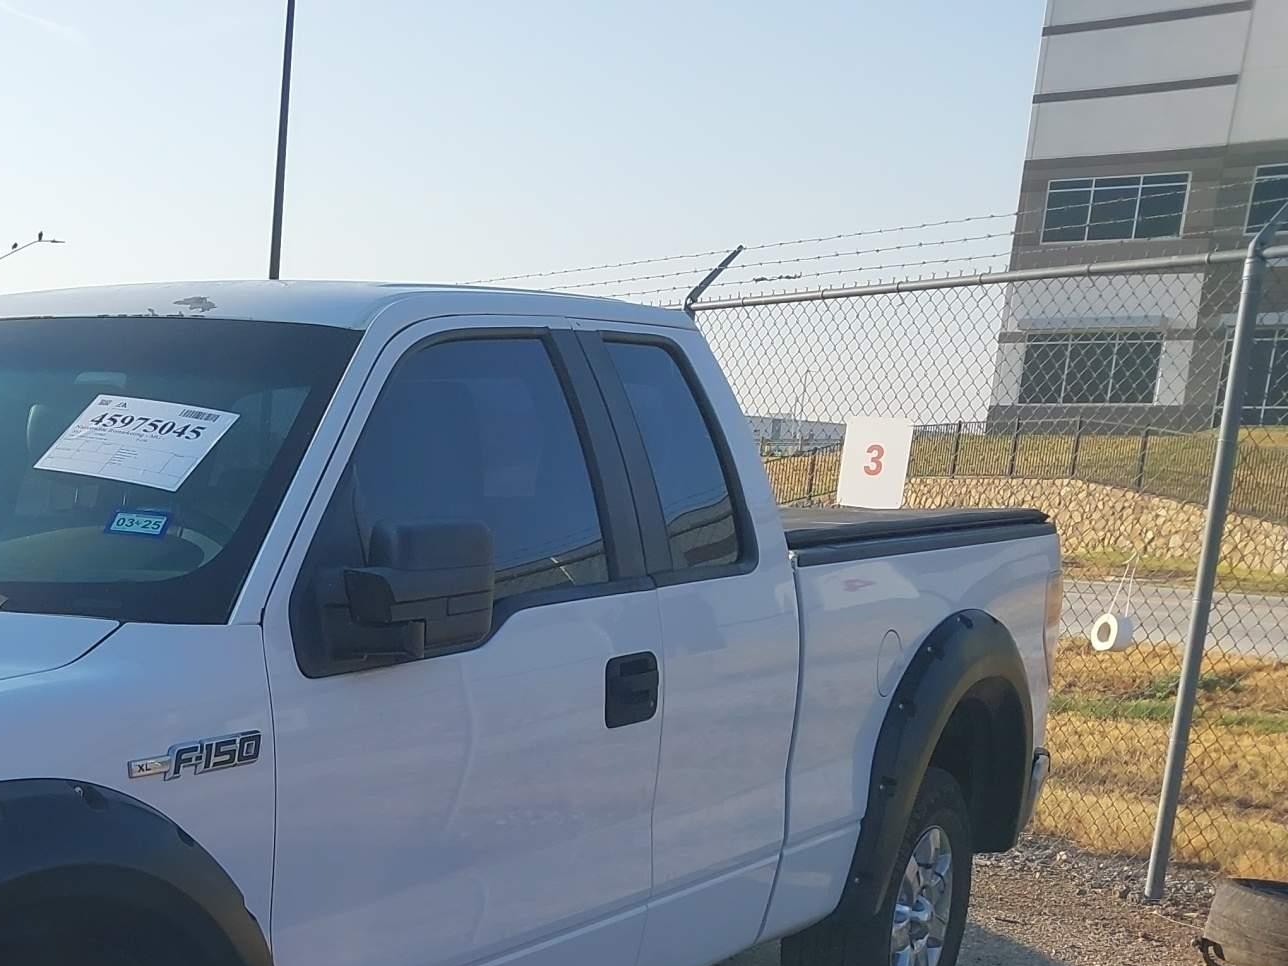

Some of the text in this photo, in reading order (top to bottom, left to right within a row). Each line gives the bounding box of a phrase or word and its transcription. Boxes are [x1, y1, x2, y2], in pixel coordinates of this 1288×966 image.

[90, 412, 207, 440] 45975045
[863, 444, 885, 476] 3
[137, 731, 262, 780] XL F-150
